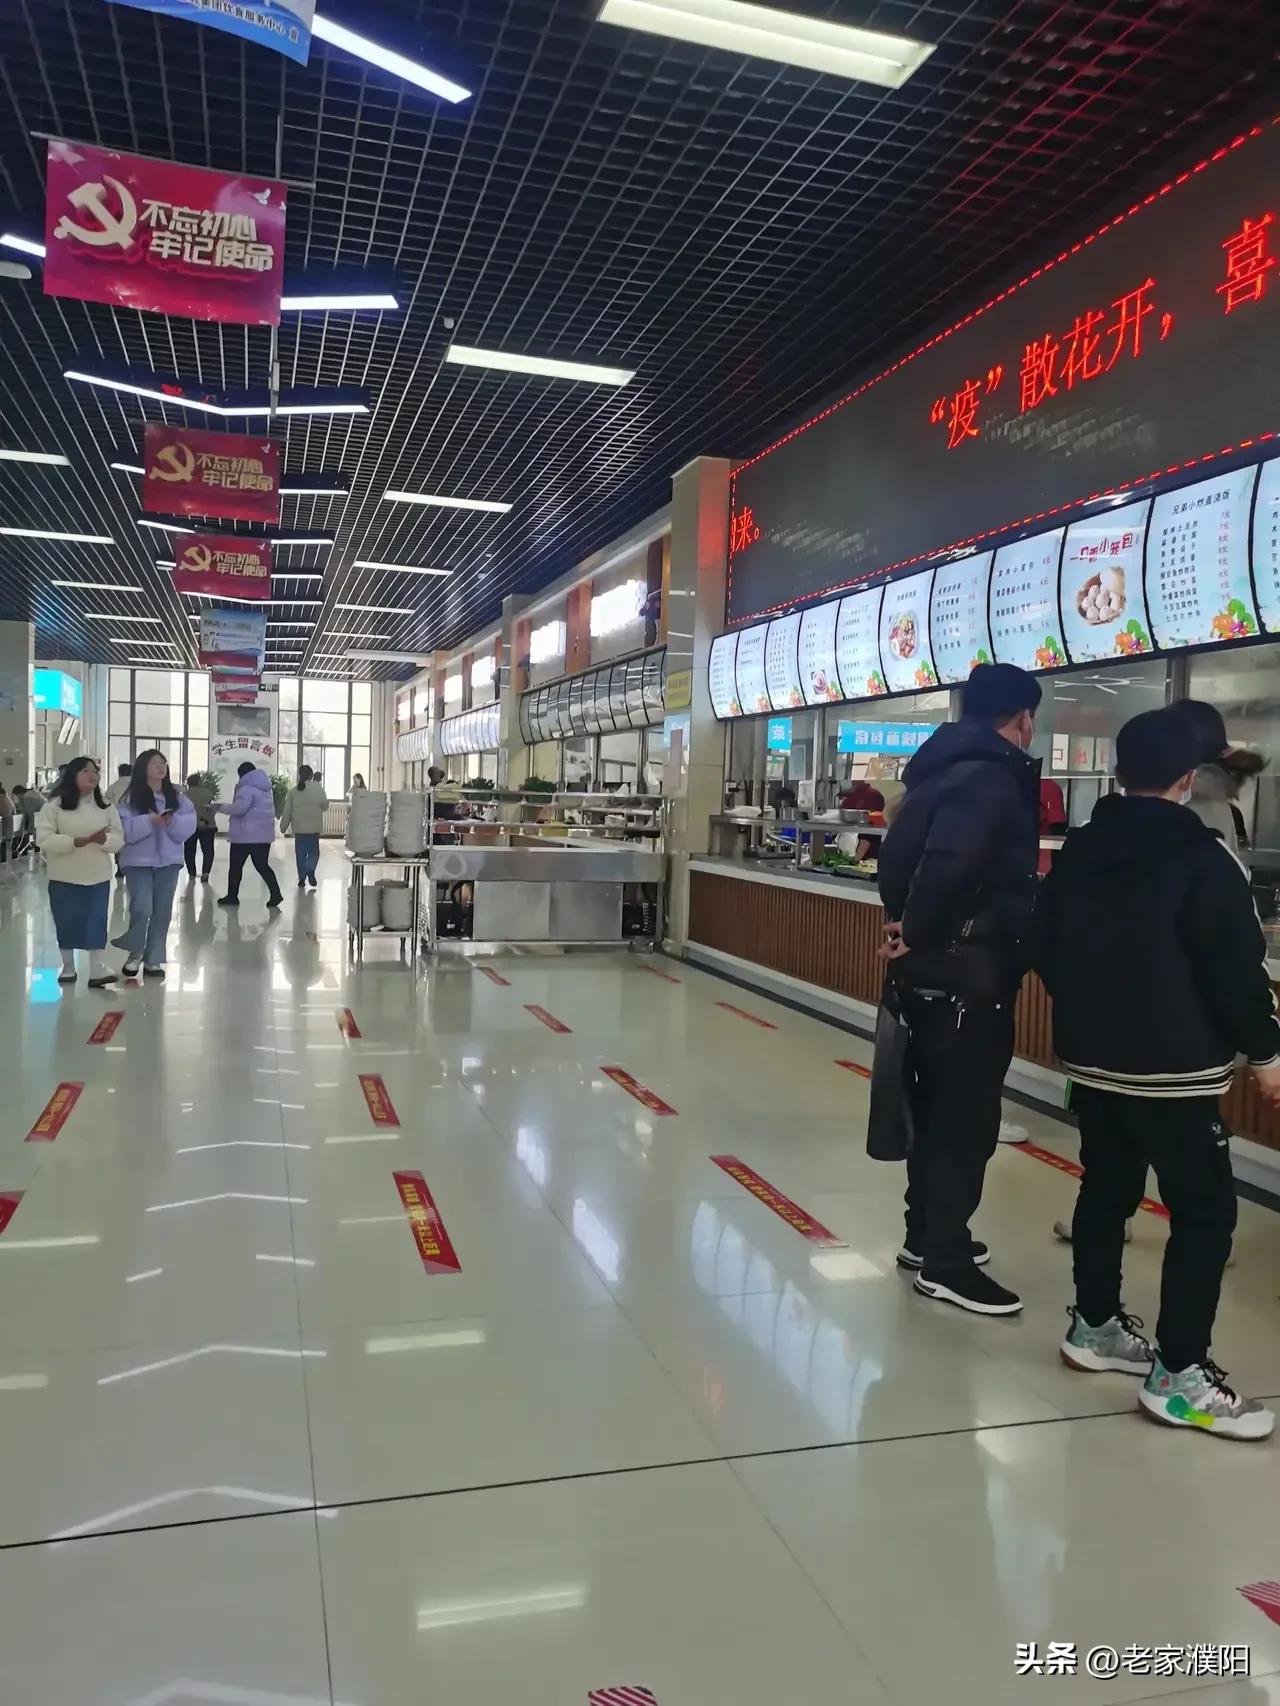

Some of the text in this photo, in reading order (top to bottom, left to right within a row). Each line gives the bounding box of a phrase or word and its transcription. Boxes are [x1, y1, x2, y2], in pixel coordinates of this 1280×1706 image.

[139, 198, 258, 241] 不忘初心
[149, 231, 274, 272] 牢记使命
[196, 452, 264, 474] 不忘初心
[201, 470, 274, 491] 牢记使命
[213, 550, 260, 566] 不忘初心
[216, 562, 268, 578] 牢记使命
[212, 737, 275, 757] 学生留言板
